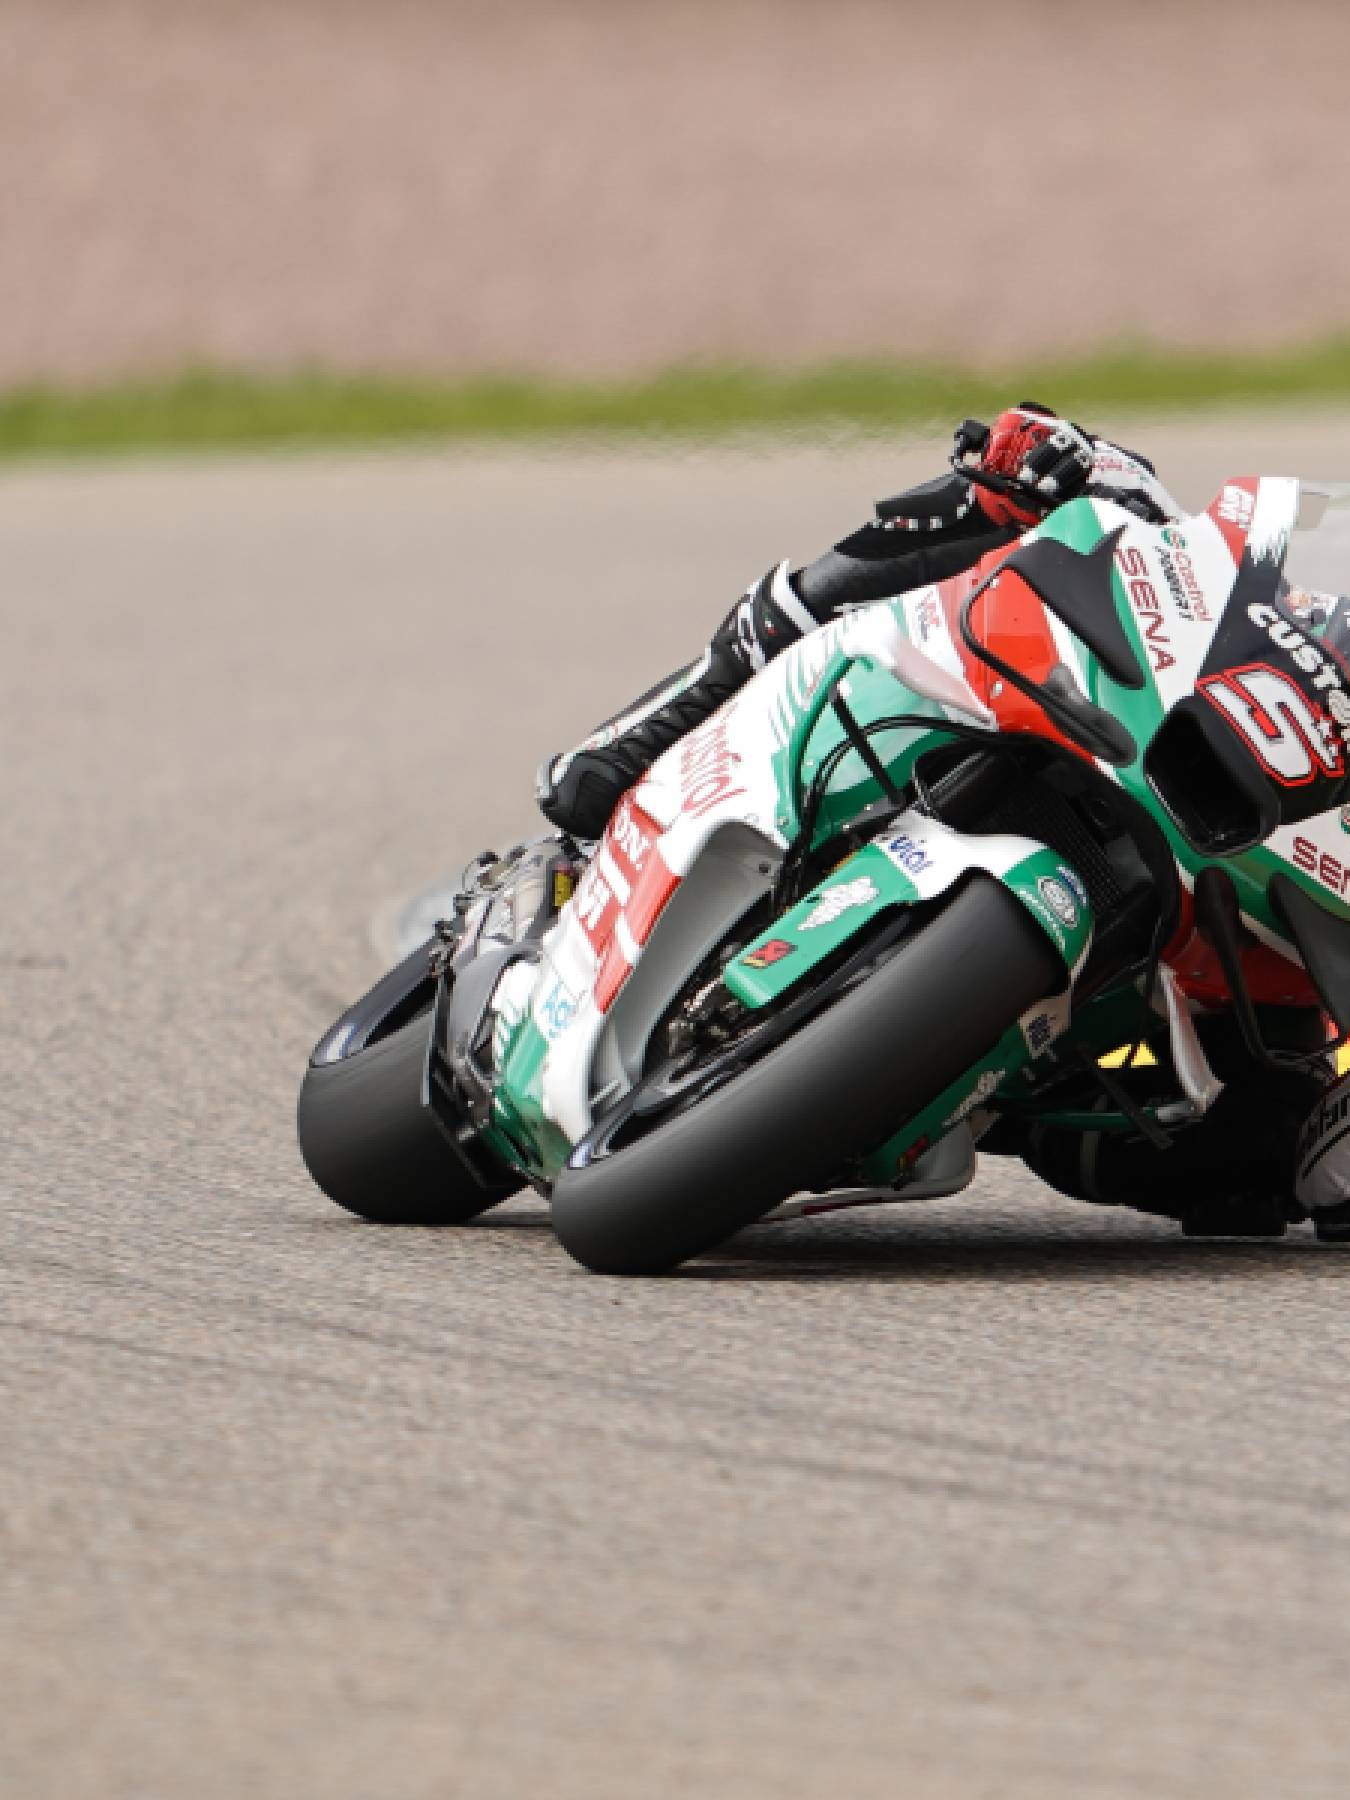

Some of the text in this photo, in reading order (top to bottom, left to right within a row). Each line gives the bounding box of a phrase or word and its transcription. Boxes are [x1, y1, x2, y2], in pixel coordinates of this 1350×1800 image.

[1113, 547, 1177, 673] SENA
[1174, 550, 1212, 622] Castrol
[1195, 662, 1345, 787] 5
